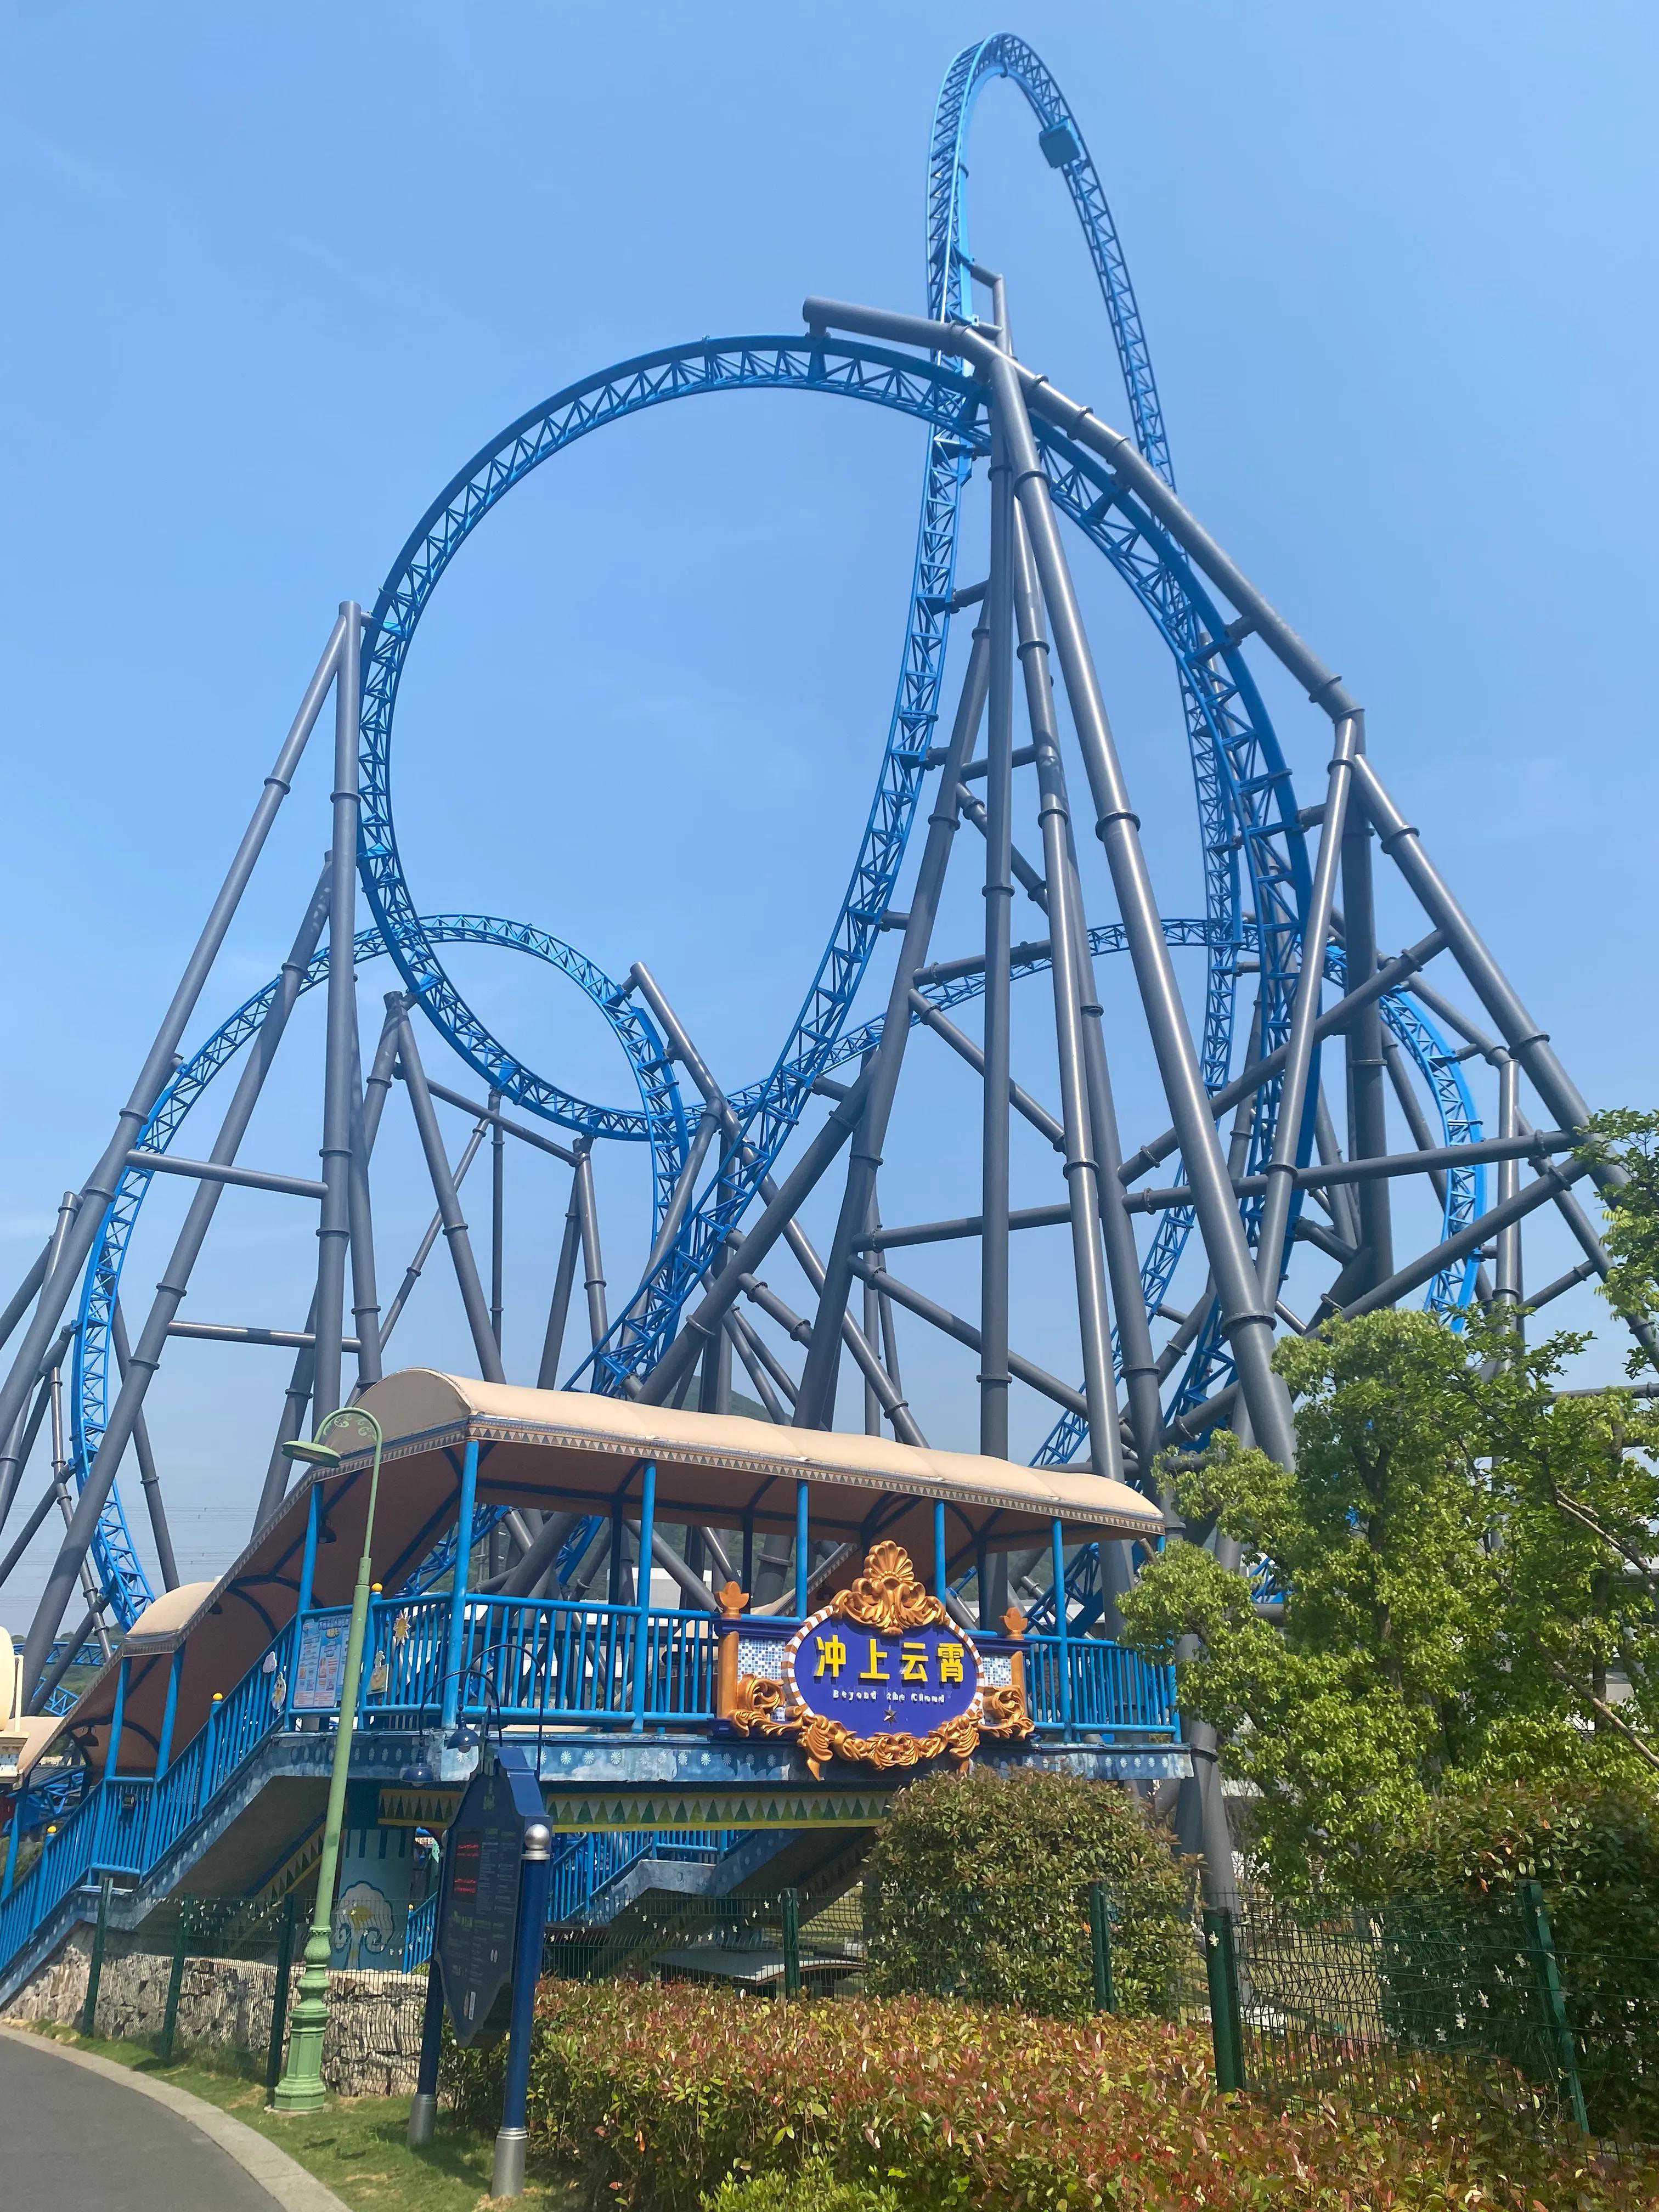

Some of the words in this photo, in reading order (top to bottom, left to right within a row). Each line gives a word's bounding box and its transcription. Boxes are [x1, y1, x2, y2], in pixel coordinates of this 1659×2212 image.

[814, 1634, 964, 1683] 冲上云霄
[833, 1689, 877, 1701] Beyond
[886, 1691, 905, 1701] the
